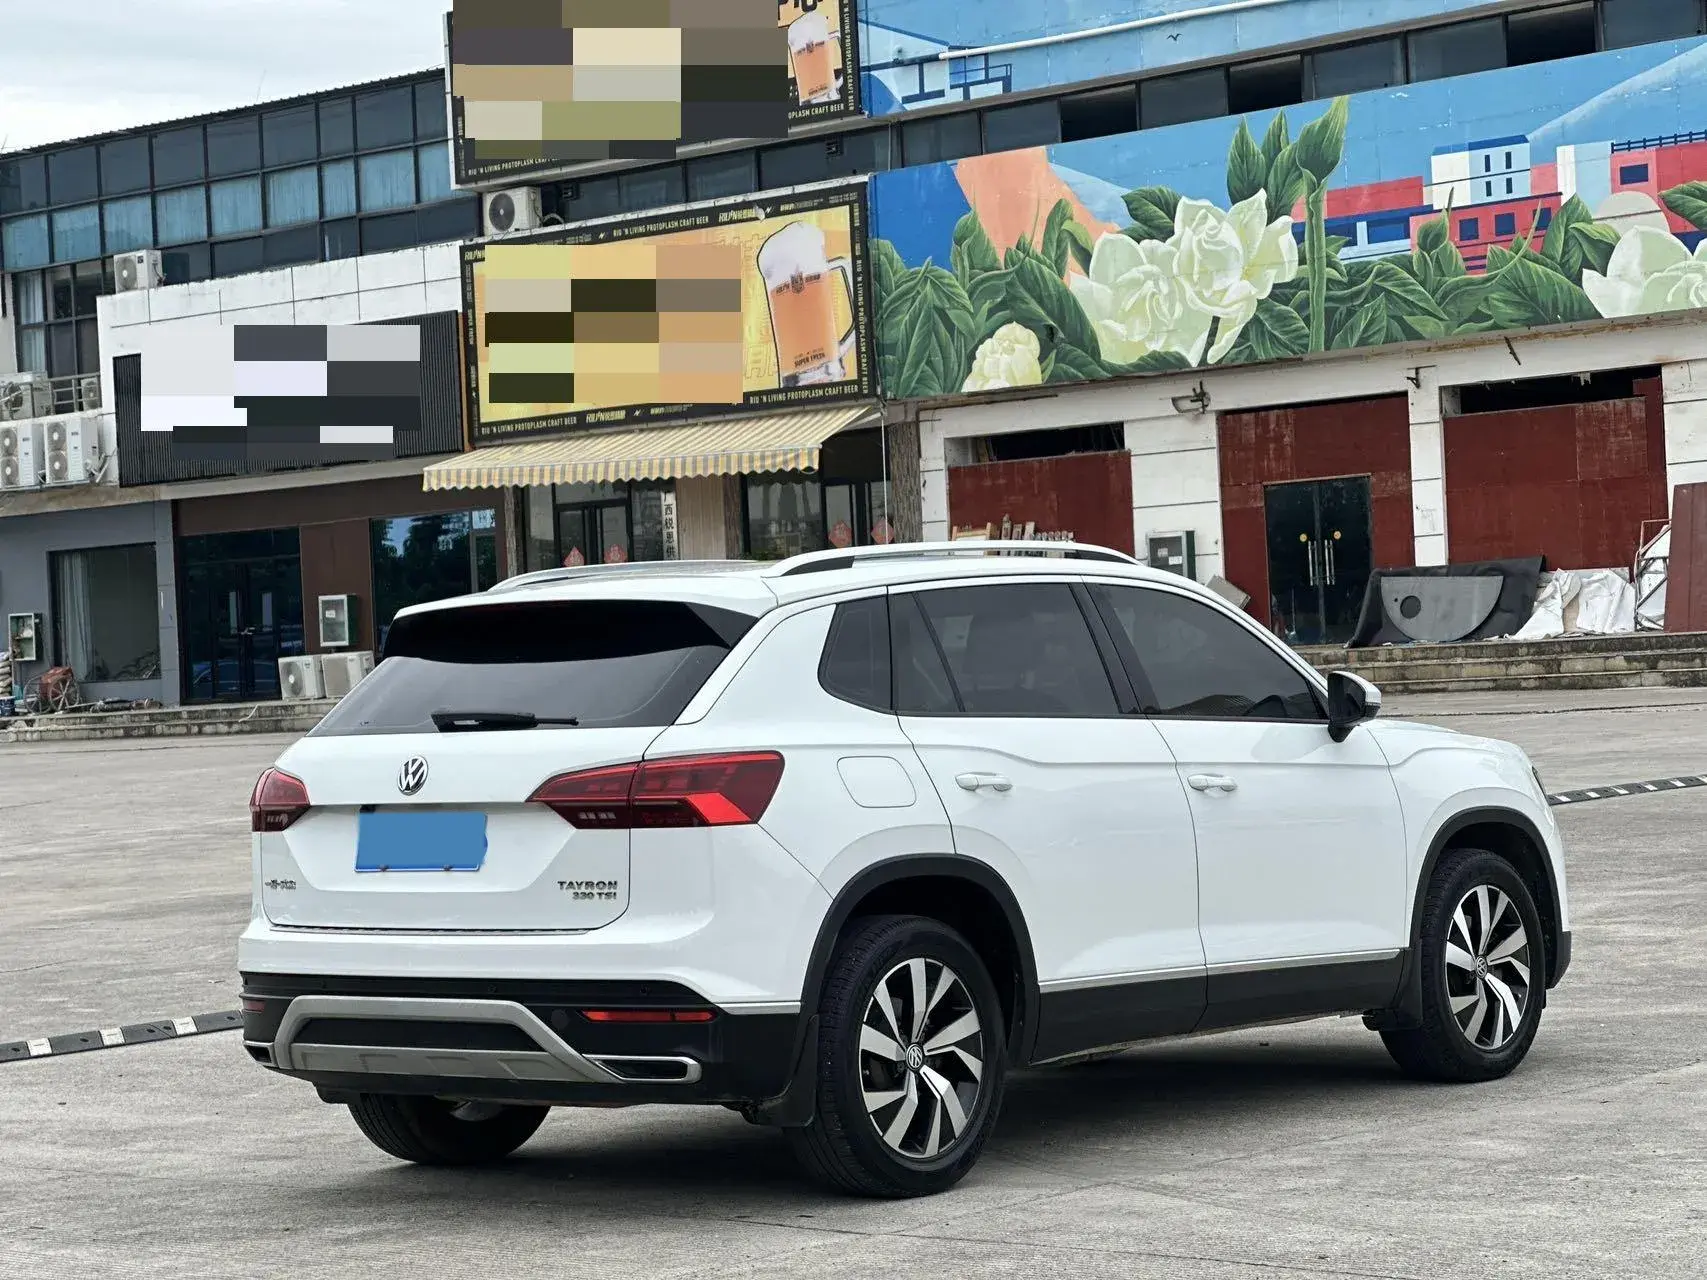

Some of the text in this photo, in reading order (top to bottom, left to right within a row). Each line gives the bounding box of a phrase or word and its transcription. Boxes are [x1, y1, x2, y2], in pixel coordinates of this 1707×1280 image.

[811, 105, 829, 116] CRAFT
[830, 103, 844, 112] BEER
[484, 163, 501, 174] LIVING
[629, 222, 646, 235] LIVING
[646, 219, 679, 233] PROTOPLASM
[679, 217, 695, 229] CRAFT
[695, 215, 709, 226] BEER
[857, 282, 865, 306] LIVING
[858, 307, 867, 352] PROTOPLASM
[794, 357, 810, 368] SUPER
[860, 353, 868, 375] CRAFT
[768, 392, 786, 402] LIVING
[787, 388, 824, 400] PROTOPLASM
[824, 386, 843, 396] CRAFT
[844, 384, 859, 394] BEER
[496, 422, 514, 433] LIVING
[514, 420, 547, 432] PROTOPLASM
[547, 417, 563, 428] CRAFT
[563, 416, 577, 426] BEER
[557, 880, 618, 890] TAYRON
[572, 891, 617, 900] 330 TSI
